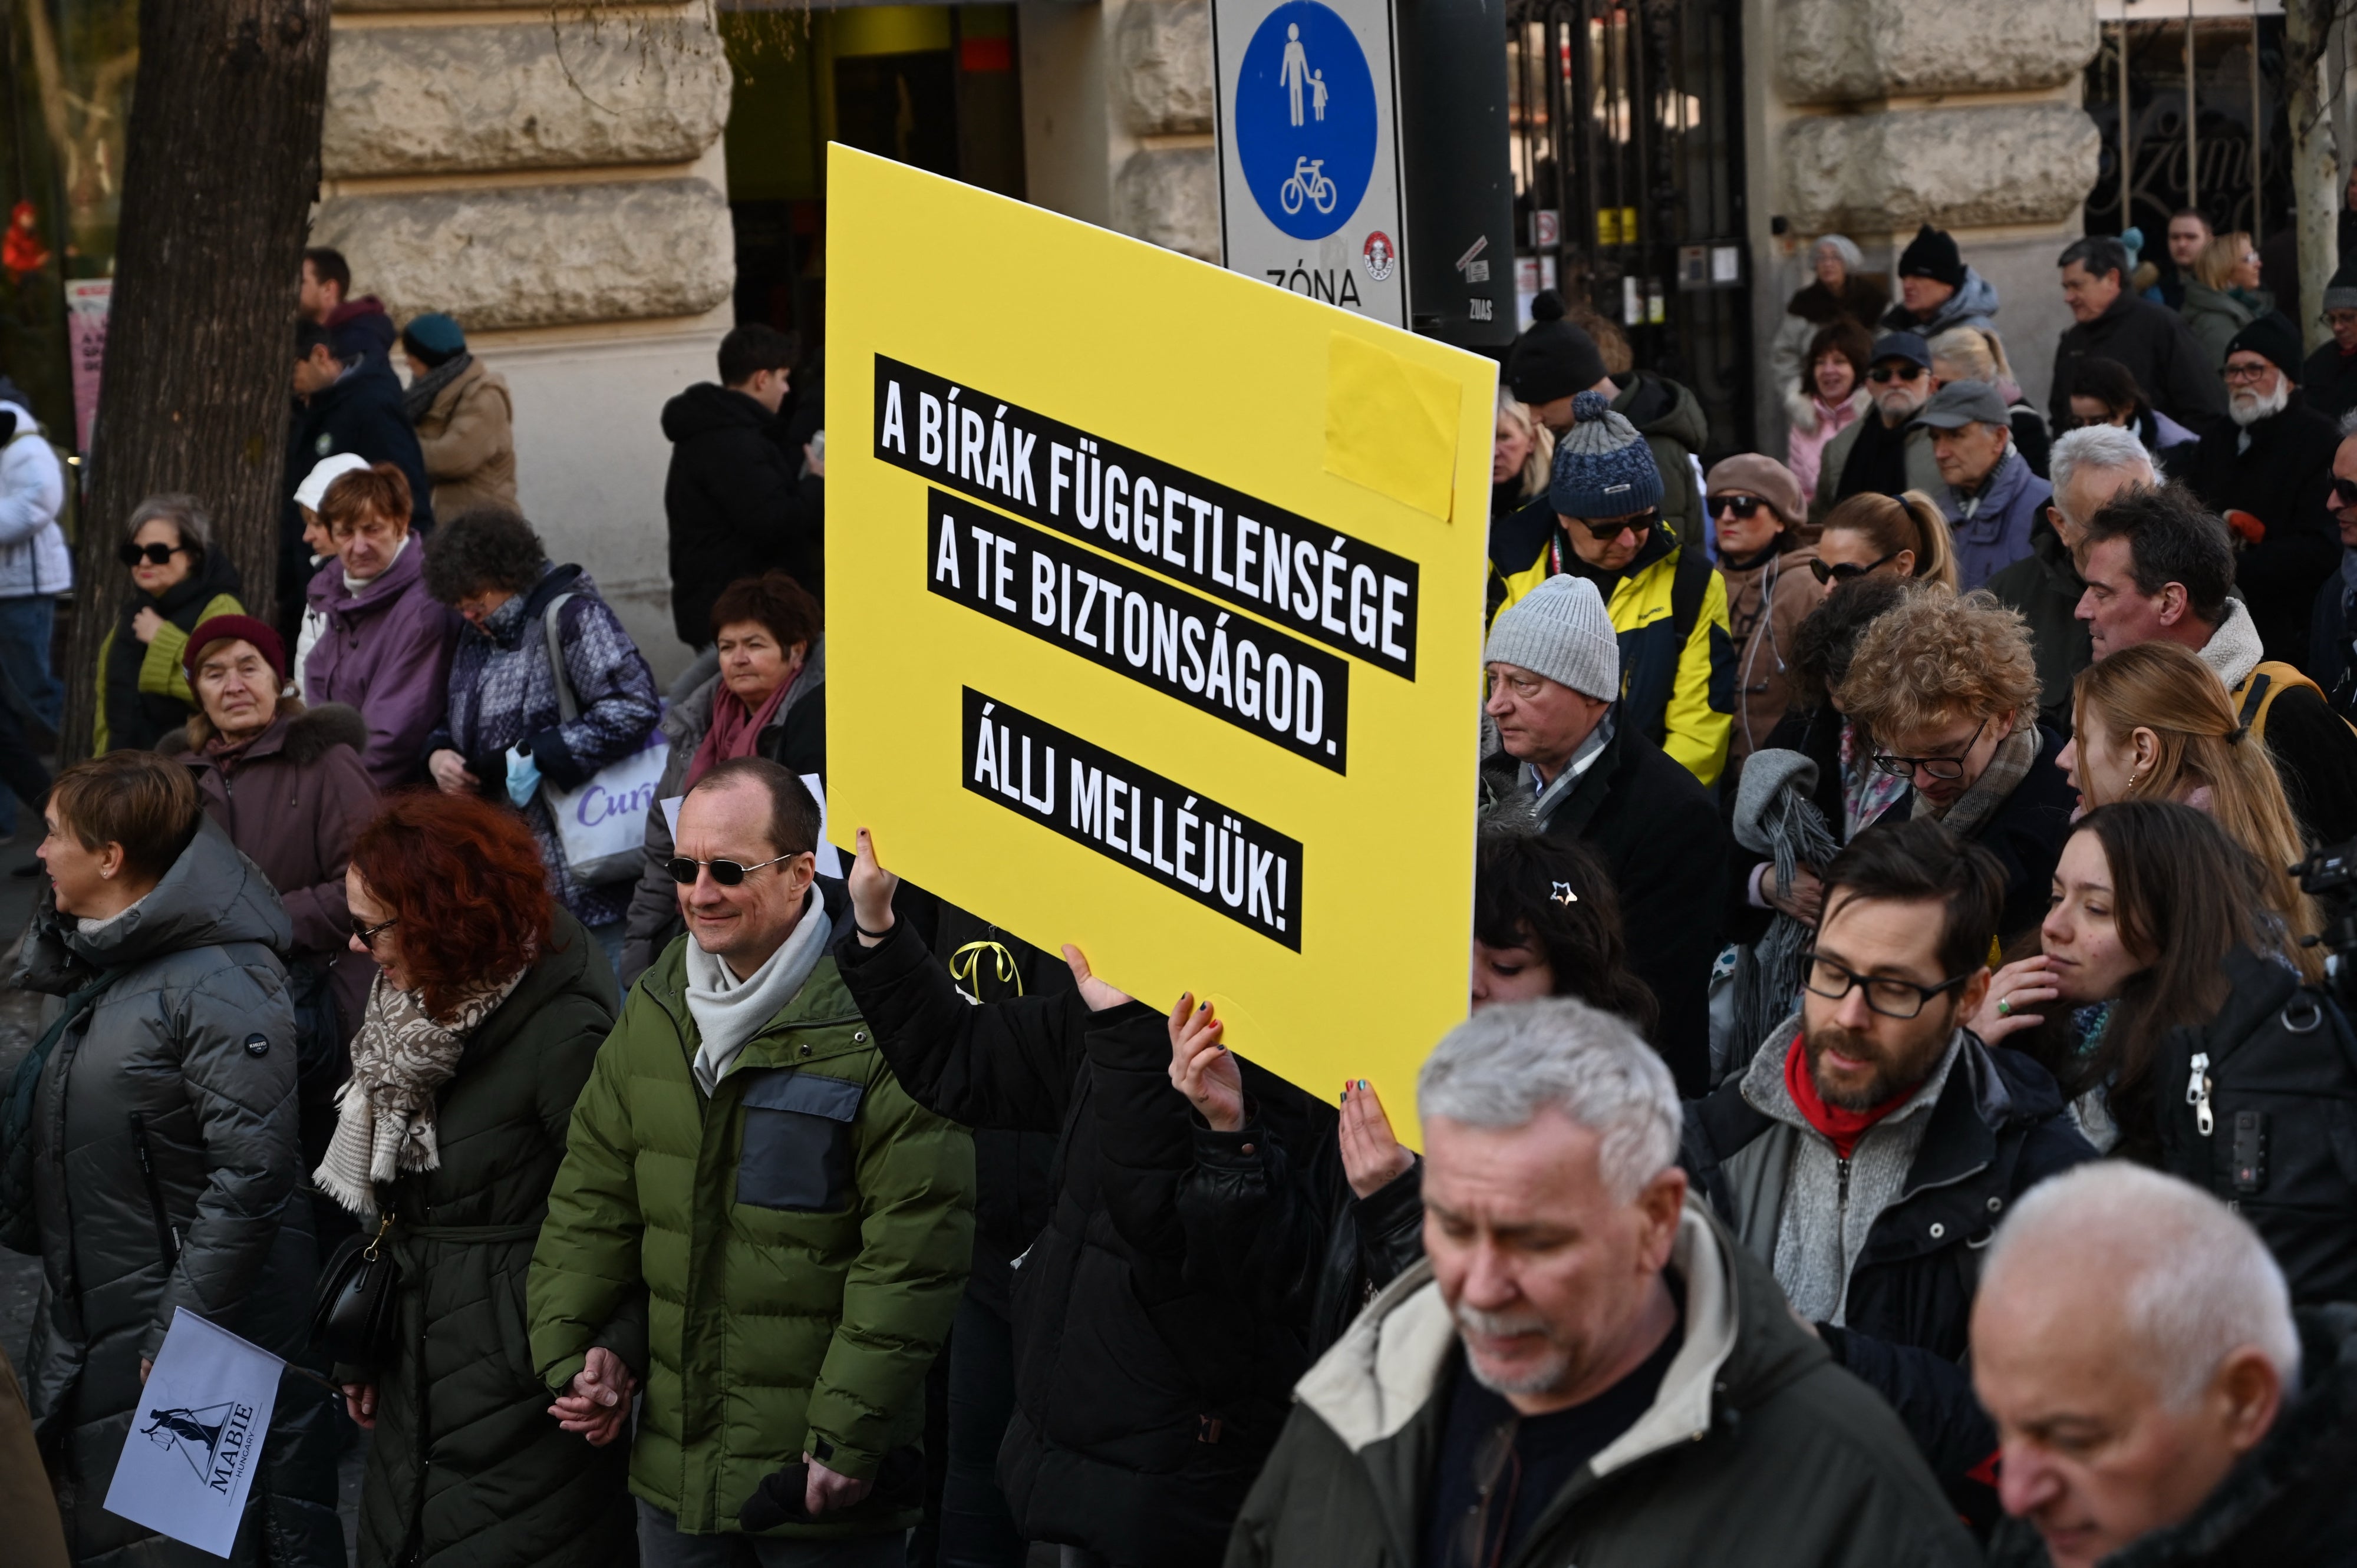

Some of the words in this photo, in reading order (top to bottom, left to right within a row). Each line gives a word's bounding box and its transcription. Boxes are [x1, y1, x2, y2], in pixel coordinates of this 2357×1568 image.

[1469, 298, 1493, 321] ZUAS
[882, 380, 906, 454] A
[919, 386, 1037, 507] BÍRÁK
[1050, 437, 1407, 662] FÜGGETLENSÉGE
[936, 514, 960, 589] A
[972, 526, 1017, 613] TE
[1032, 550, 1336, 755] BIZTONSÁGOD.
[974, 702, 1054, 815] ÁLLJ
[1070, 758, 1287, 932] MELLÉJÜK!
[248, 1041, 266, 1049] KHUJO
[209, 1404, 253, 1496] MABIE
[235, 1431, 255, 1478] HUNGARY
